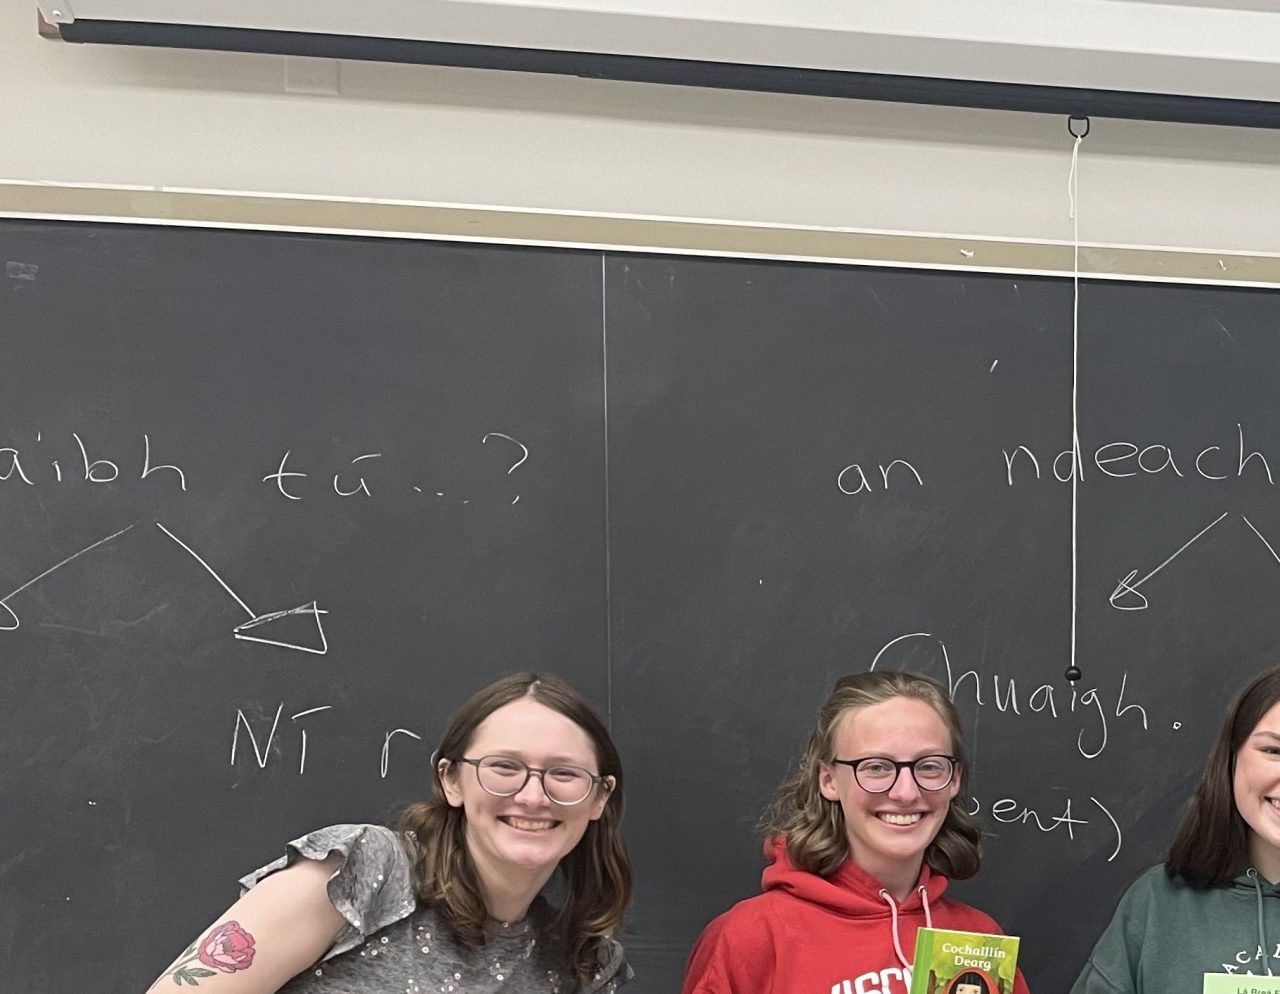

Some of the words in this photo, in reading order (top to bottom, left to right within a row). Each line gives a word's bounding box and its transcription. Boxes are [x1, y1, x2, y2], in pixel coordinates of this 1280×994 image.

[838, 456, 923, 495] an
[942, 942, 1006, 958] Cochaillín
[954, 955, 991, 972] Dearg
